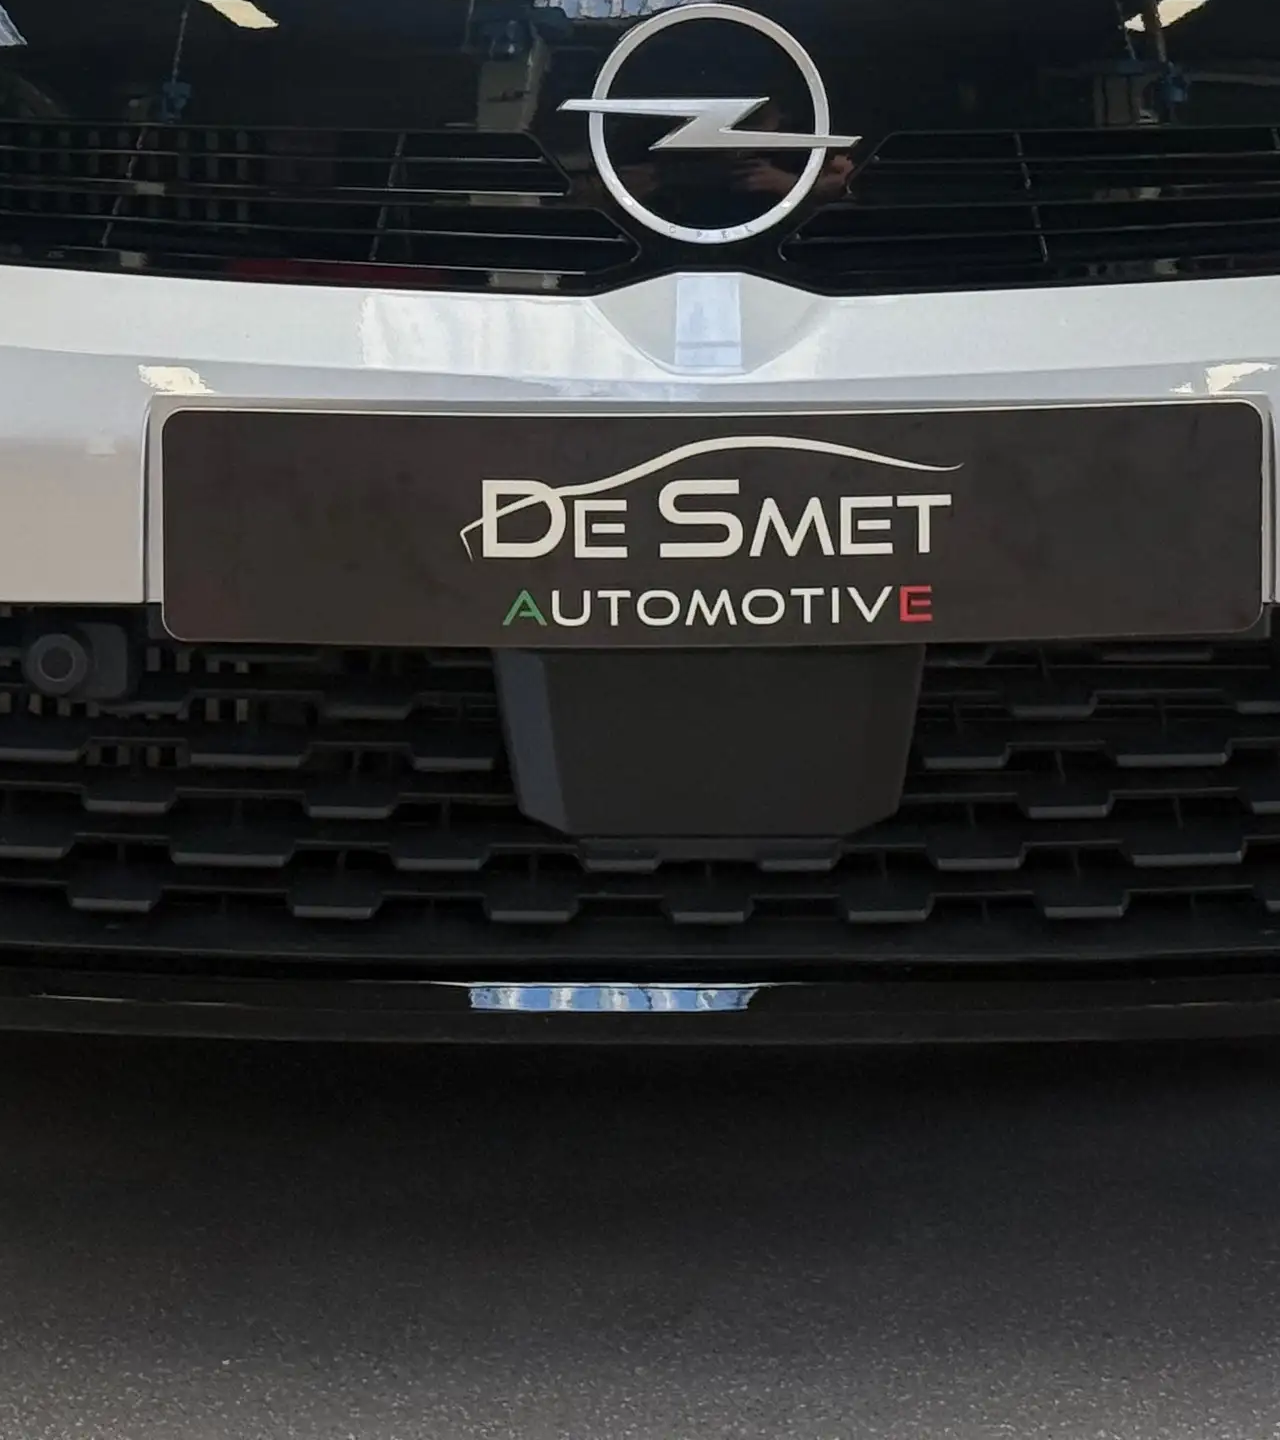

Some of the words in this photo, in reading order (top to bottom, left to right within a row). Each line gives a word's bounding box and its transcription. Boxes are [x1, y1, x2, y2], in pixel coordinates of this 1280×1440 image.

[668, 225, 755, 239] OPEL
[658, 478, 951, 558] SMET
[502, 585, 933, 627] AUTOMOTIVE
